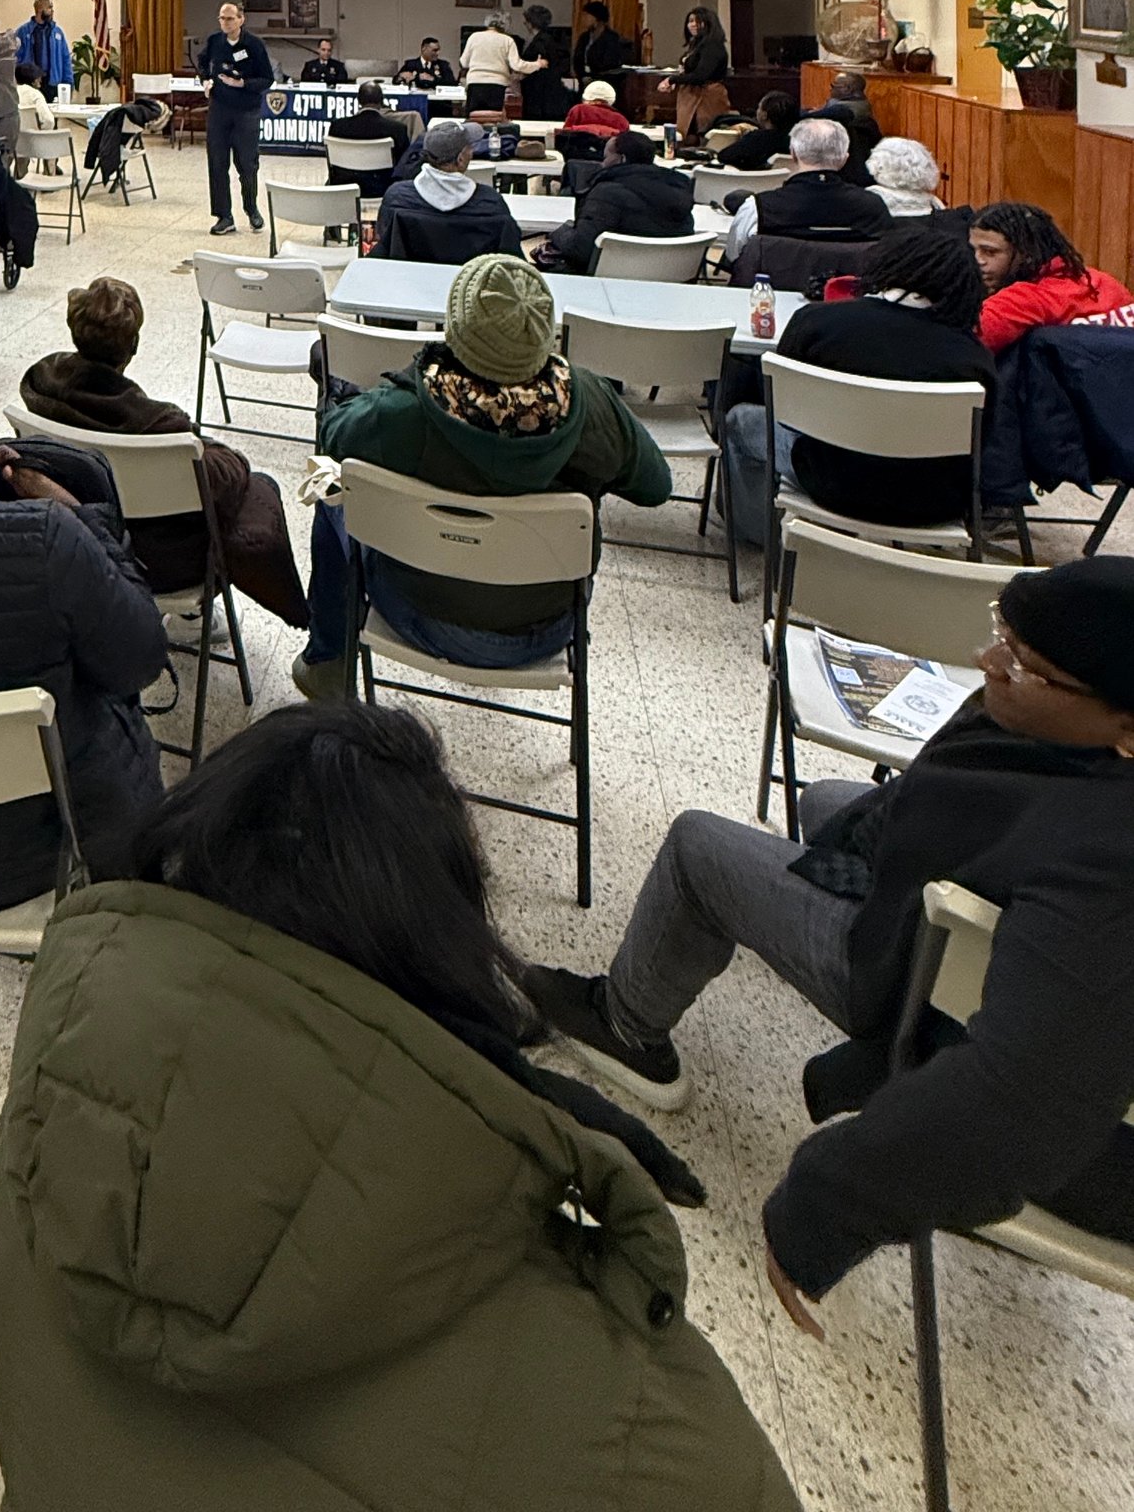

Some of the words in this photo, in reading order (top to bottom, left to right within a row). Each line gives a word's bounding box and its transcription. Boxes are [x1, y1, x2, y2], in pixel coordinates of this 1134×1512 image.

[292, 94, 322, 117] 47TH
[326, 96, 399, 119] PRECT
[259, 118, 332, 143] OMMUNIT
